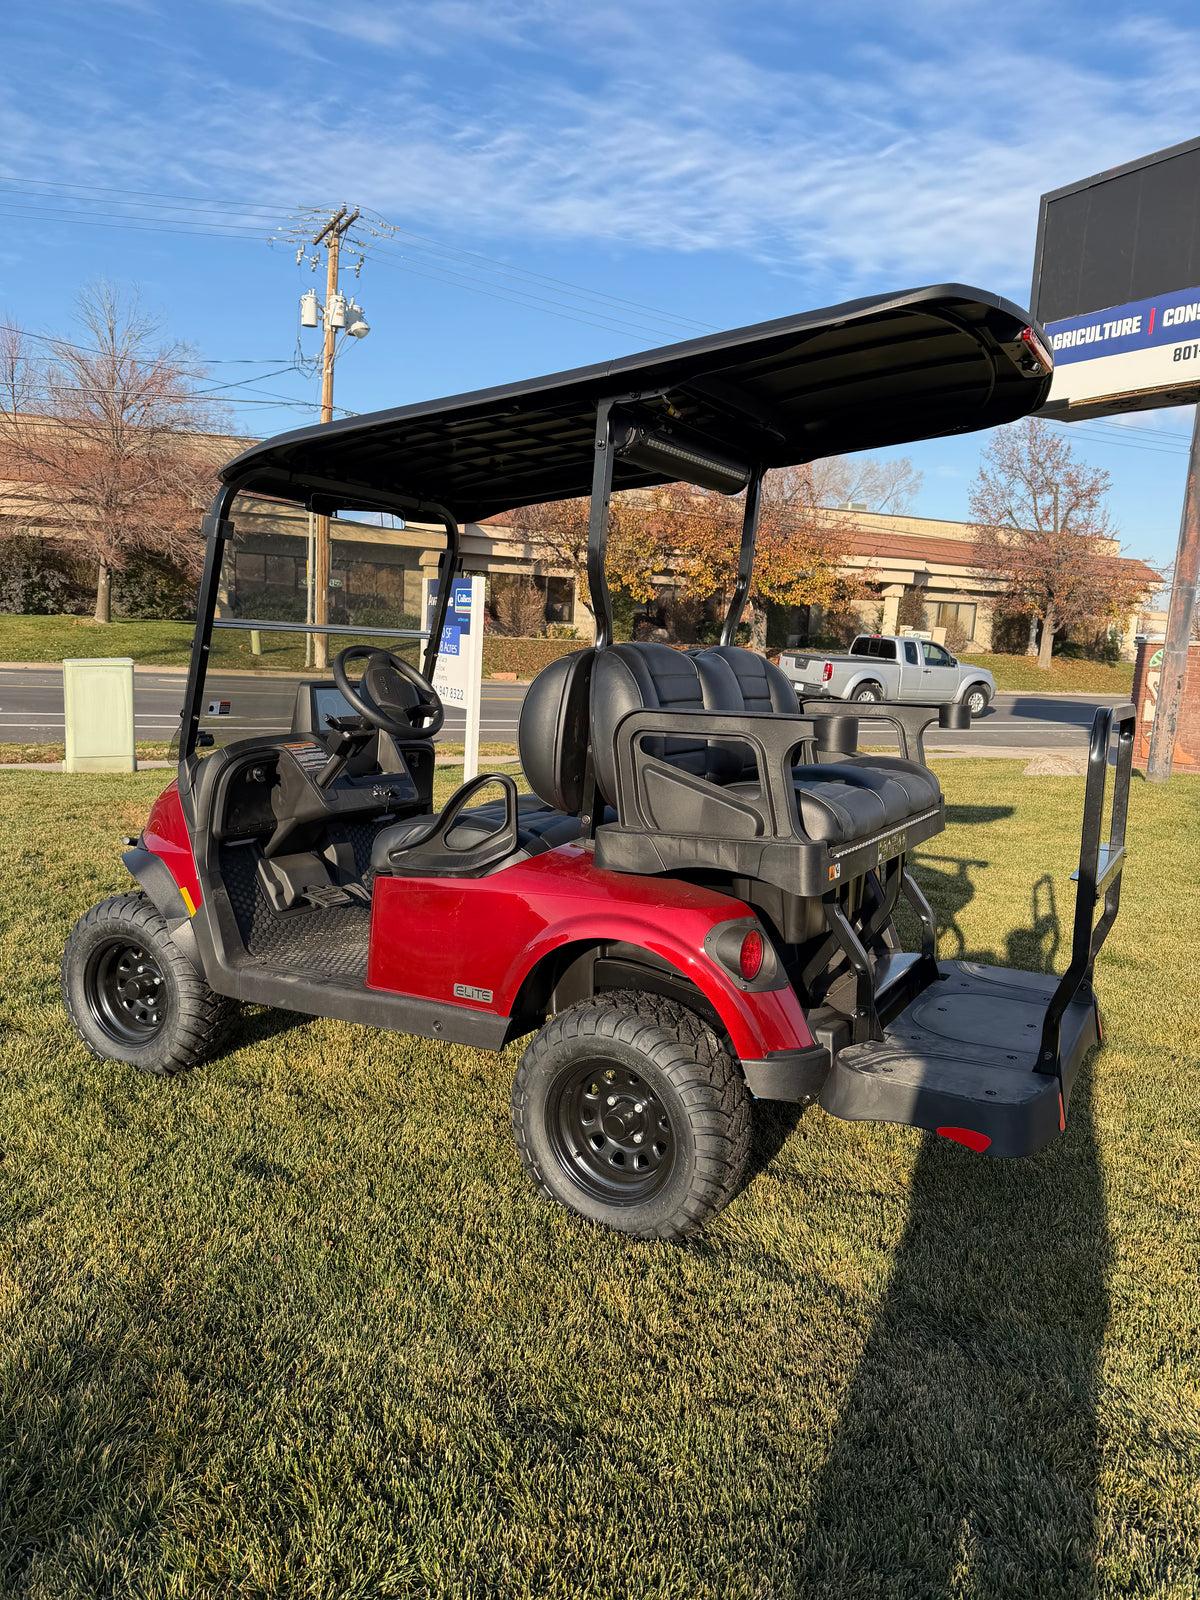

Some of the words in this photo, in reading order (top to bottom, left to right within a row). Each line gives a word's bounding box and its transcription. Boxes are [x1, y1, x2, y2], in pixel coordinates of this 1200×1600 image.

[444, 641, 458, 654] Acres
[439, 685, 449, 697] 947
[450, 687, 464, 700] 8322
